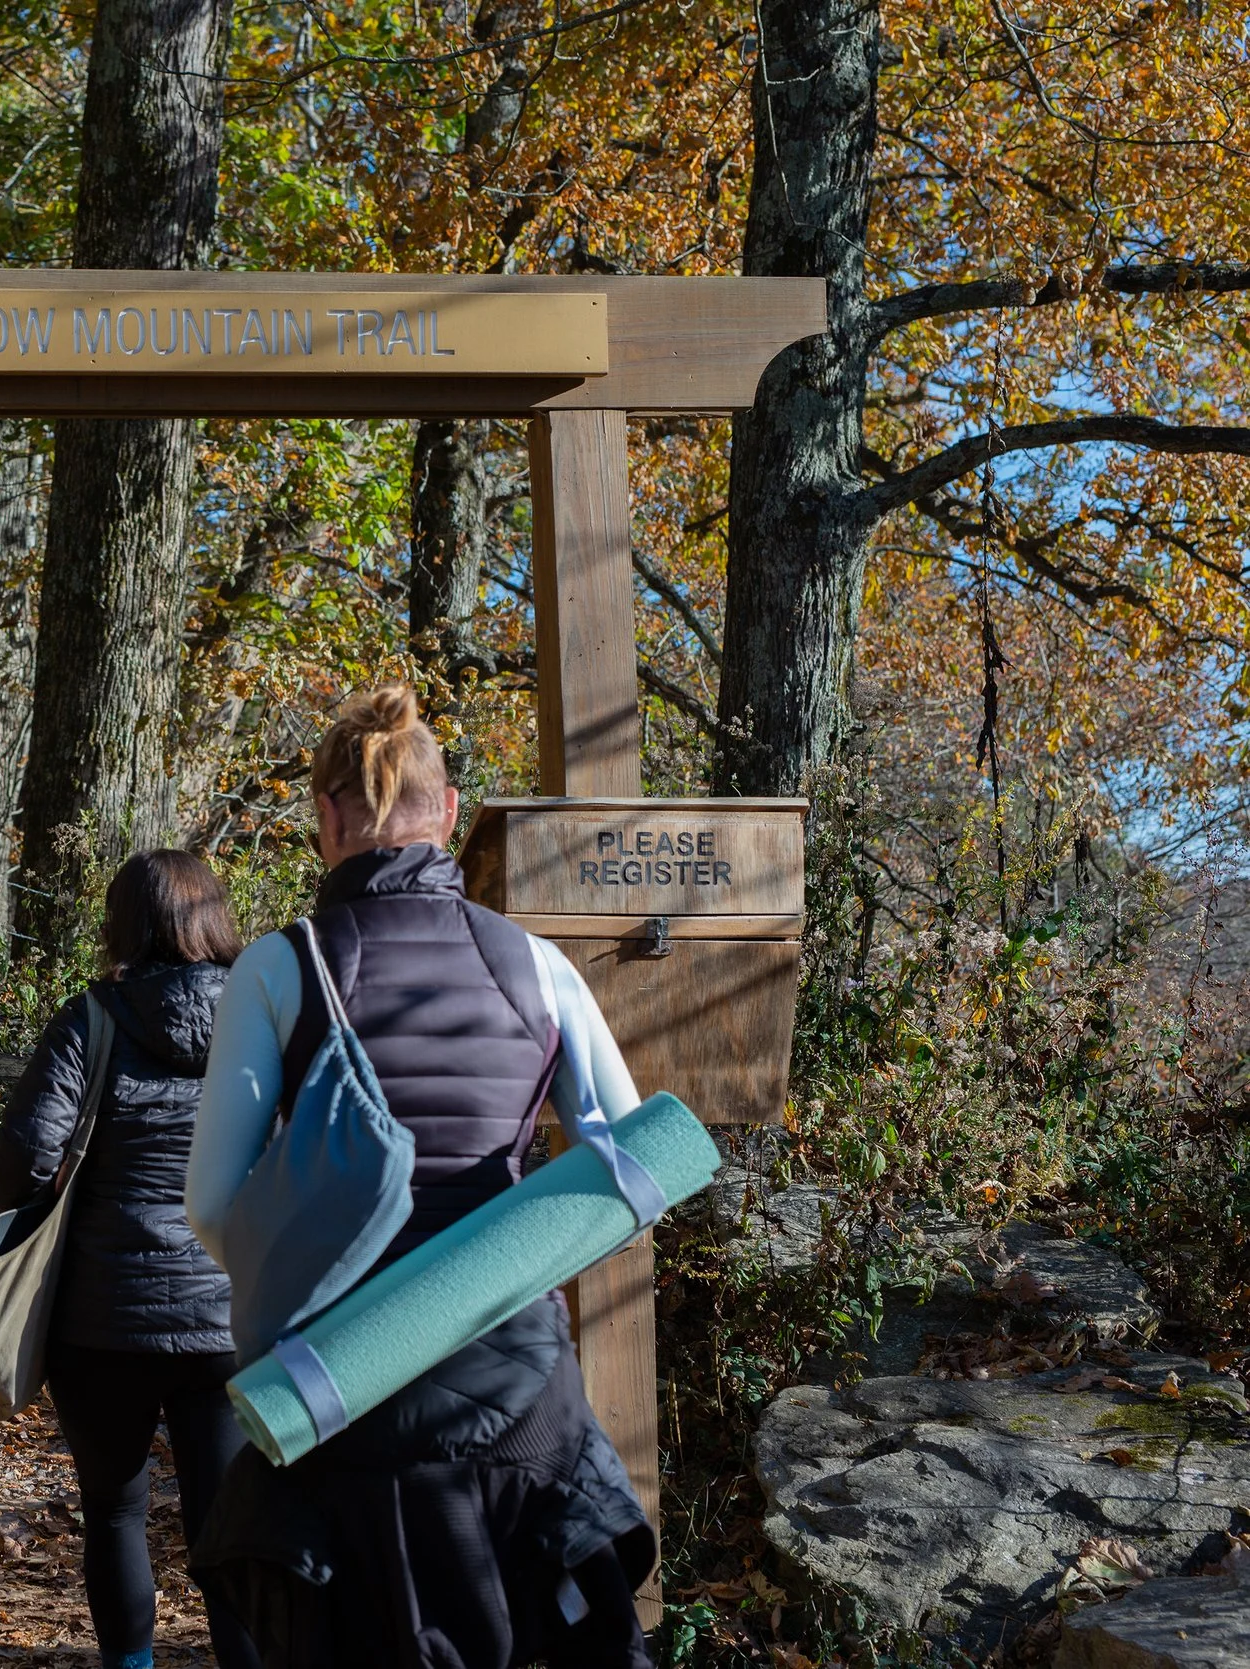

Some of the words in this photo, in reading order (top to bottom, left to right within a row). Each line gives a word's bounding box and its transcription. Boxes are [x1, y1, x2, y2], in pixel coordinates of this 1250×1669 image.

[73, 307, 313, 356] MOUNTAIN
[326, 308, 456, 357] TRAIL
[597, 831, 715, 857] PLEASE
[579, 860, 732, 886] REGISTER
